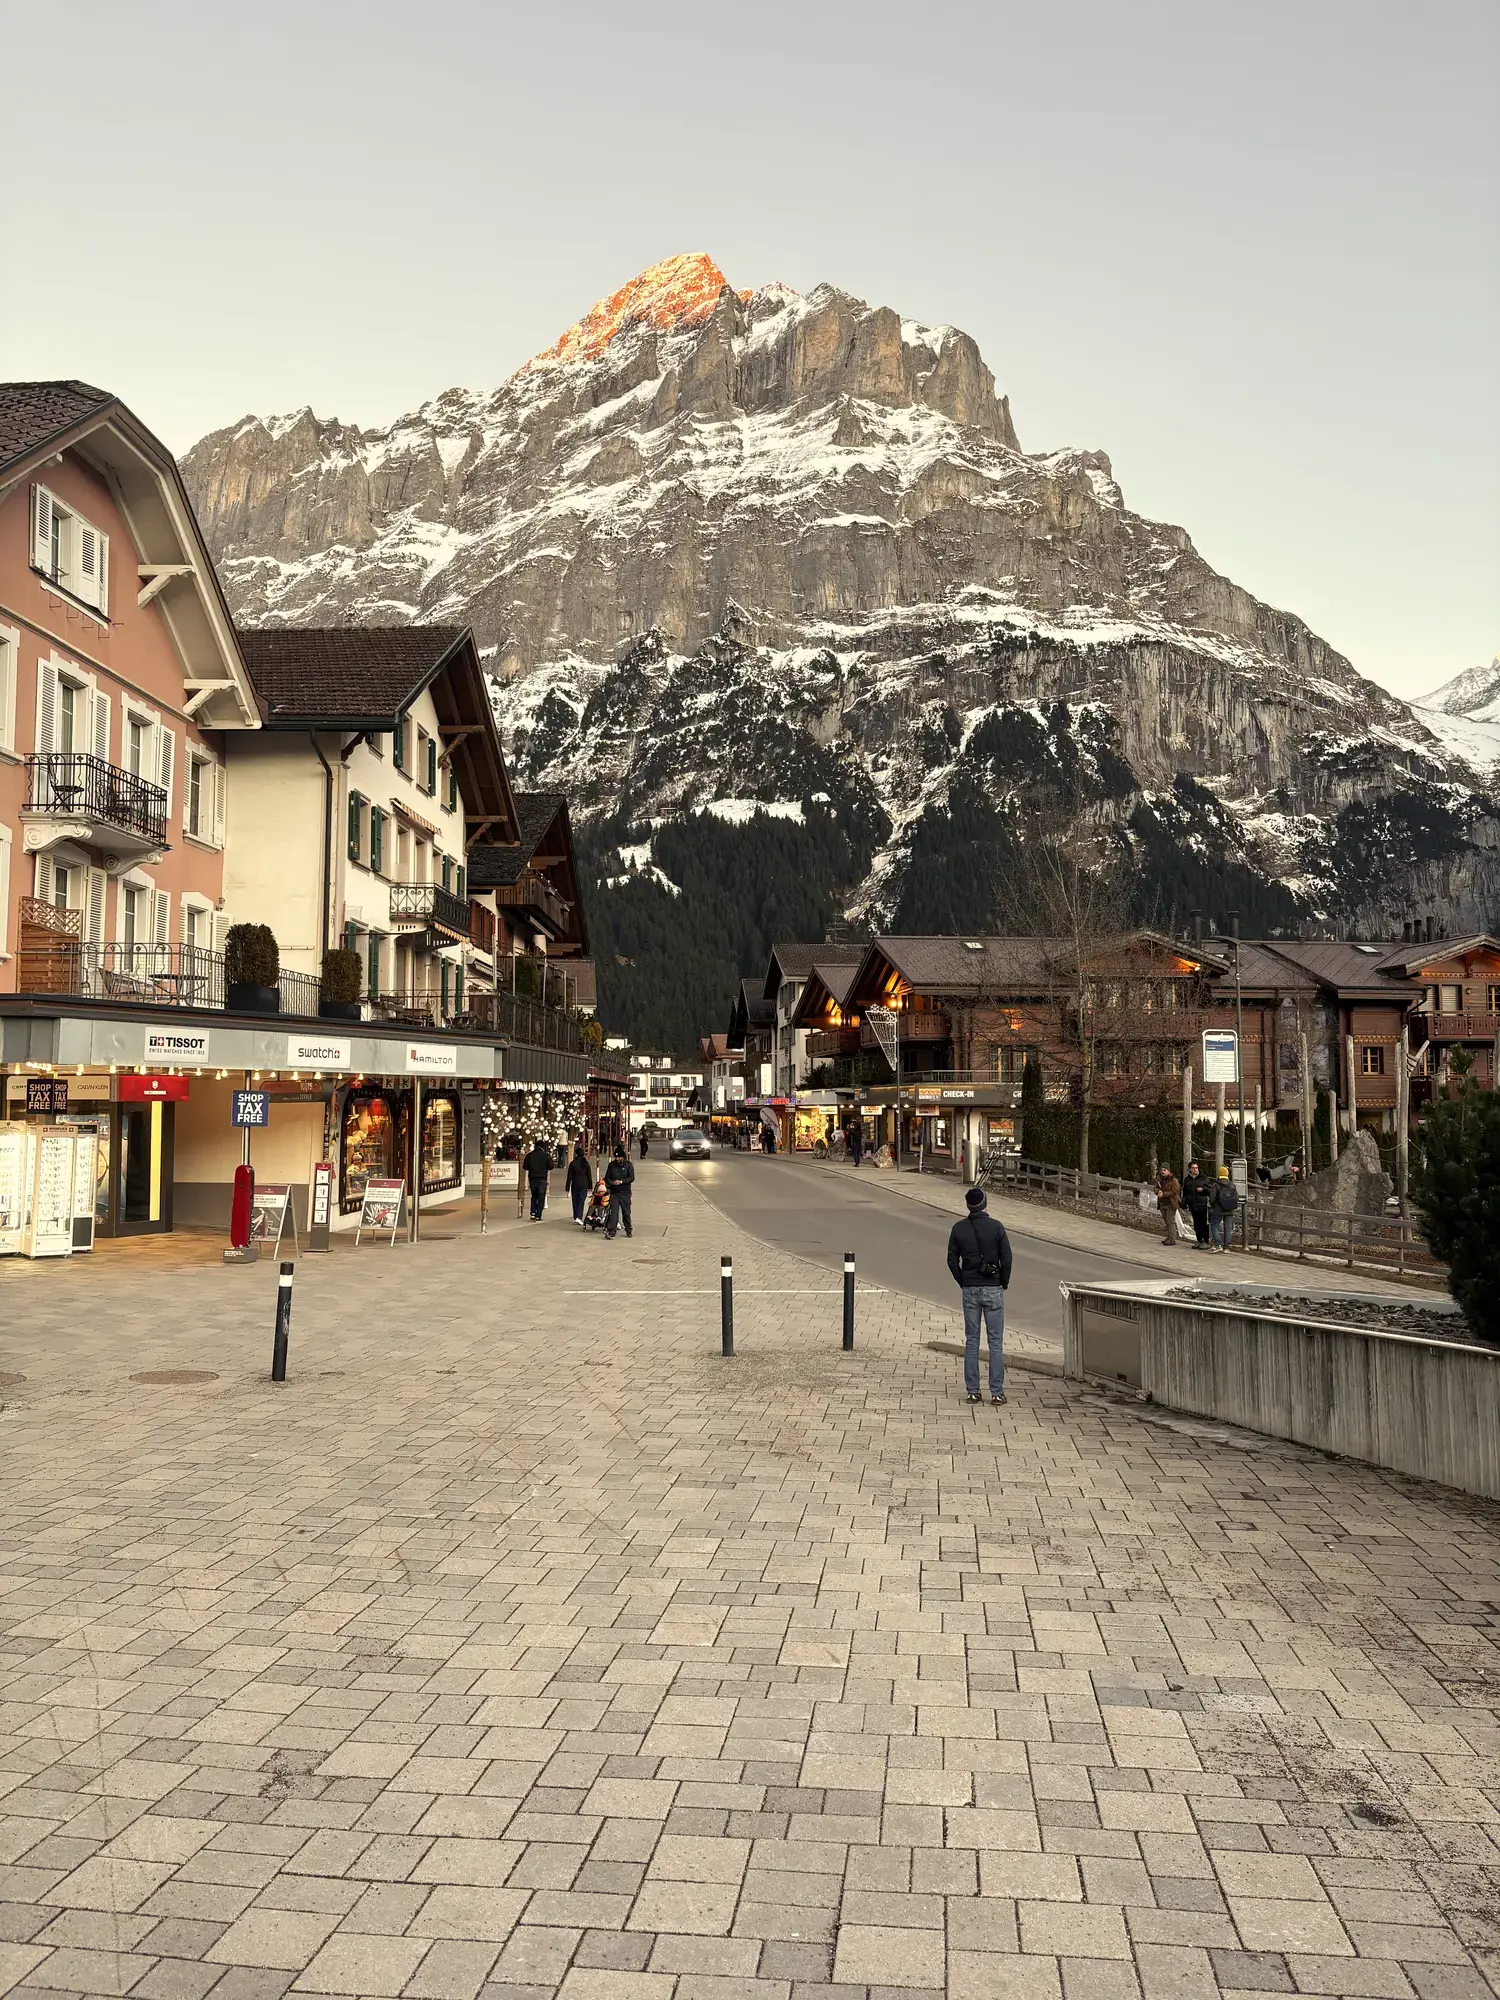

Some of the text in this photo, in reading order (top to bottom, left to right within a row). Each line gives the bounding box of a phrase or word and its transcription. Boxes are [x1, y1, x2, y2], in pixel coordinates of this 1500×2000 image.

[165, 1037, 205, 1049] TISSOT
[298, 1047, 334, 1059] swatch
[413, 1056, 453, 1065] HAMILTON
[29, 1083, 52, 1092] SHOP
[54, 1083, 67, 1092] SHOP
[29, 1092, 50, 1101] TAX
[54, 1092, 67, 1102] TAX
[238, 1093, 264, 1102] SHOP
[943, 1090, 975, 1098] CHECK-IN
[28, 1101, 50, 1110] FREE
[54, 1101, 67, 1110] FREE
[237, 1102, 263, 1114] TAX
[237, 1113, 263, 1123] FREE
